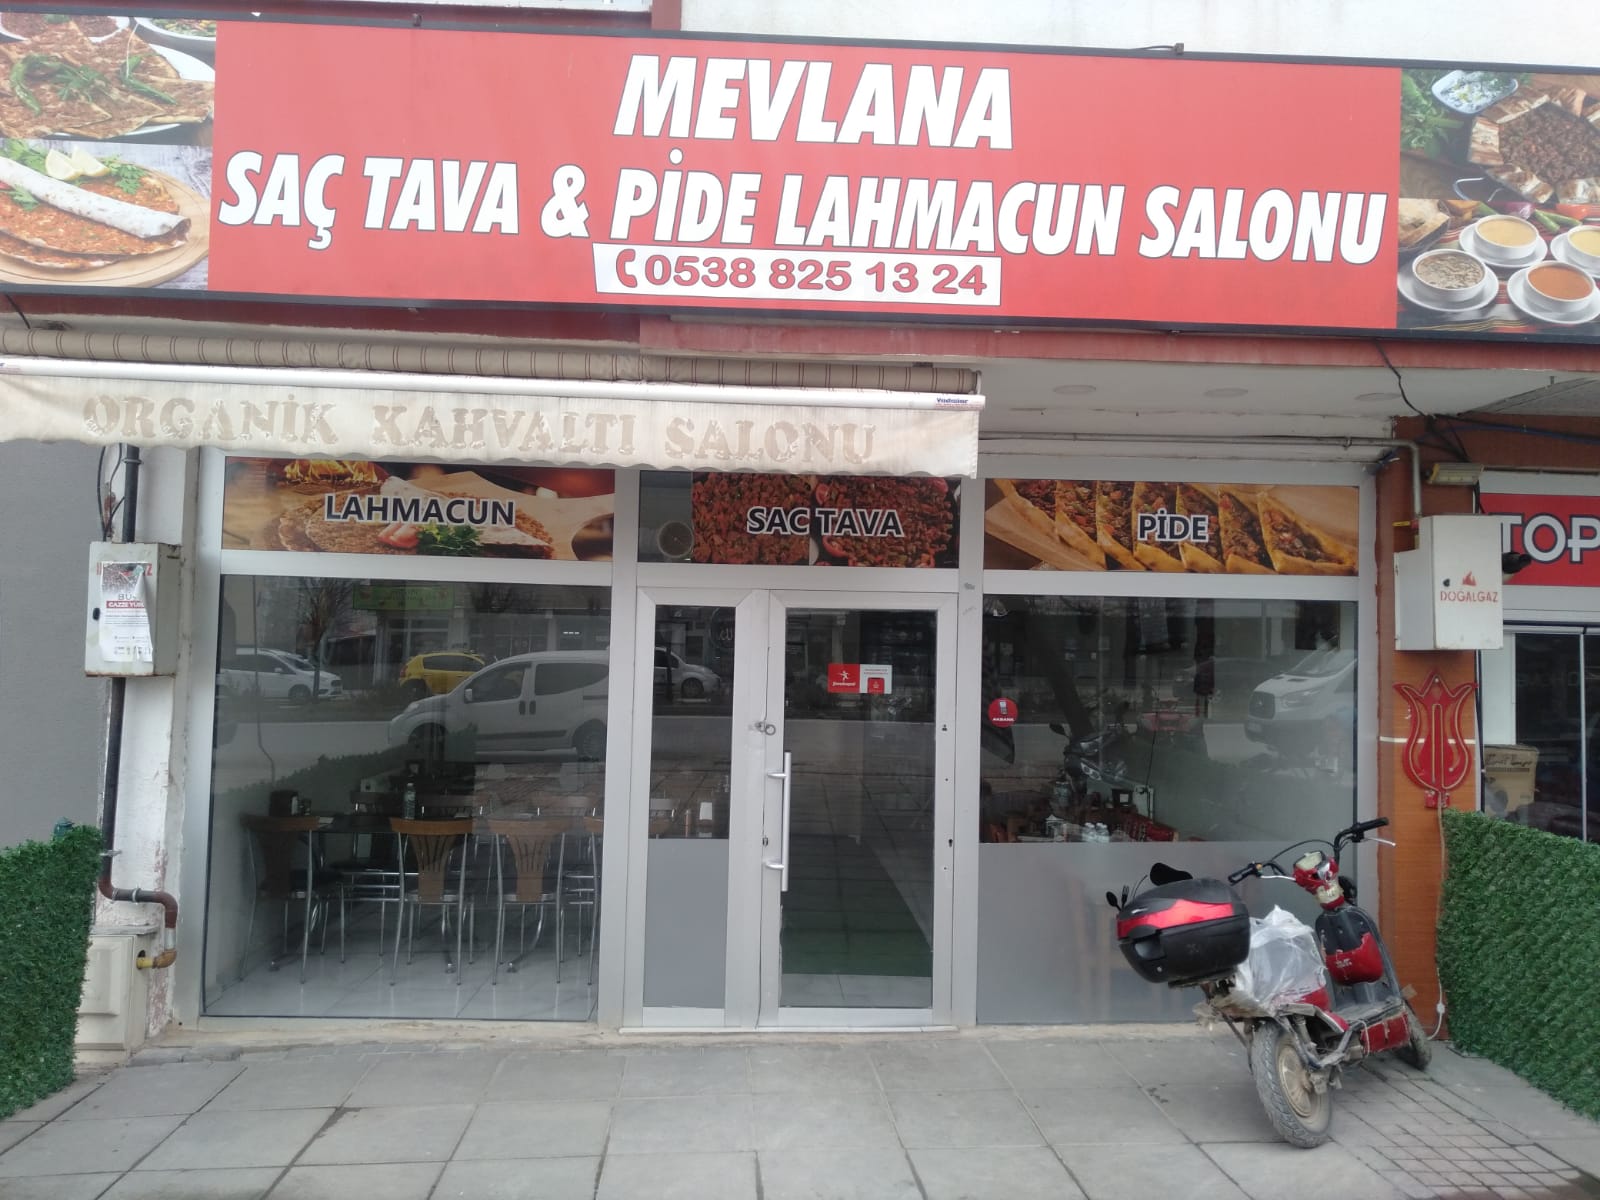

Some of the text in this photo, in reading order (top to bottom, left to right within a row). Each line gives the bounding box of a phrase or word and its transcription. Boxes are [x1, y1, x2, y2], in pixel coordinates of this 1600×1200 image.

[612, 54, 1013, 150] MEVLANA
[217, 148, 1388, 265] SAÇ TAVA & PİDE LAHMACUN SALONU
[644, 254, 987, 296] 0538 825 13 24
[83, 393, 876, 464] ORGANİK KAHVALTI SALONU
[324, 494, 515, 527] LAHMACUN
[746, 506, 905, 538] SAC TAVA
[1136, 508, 1209, 542] PİDE
